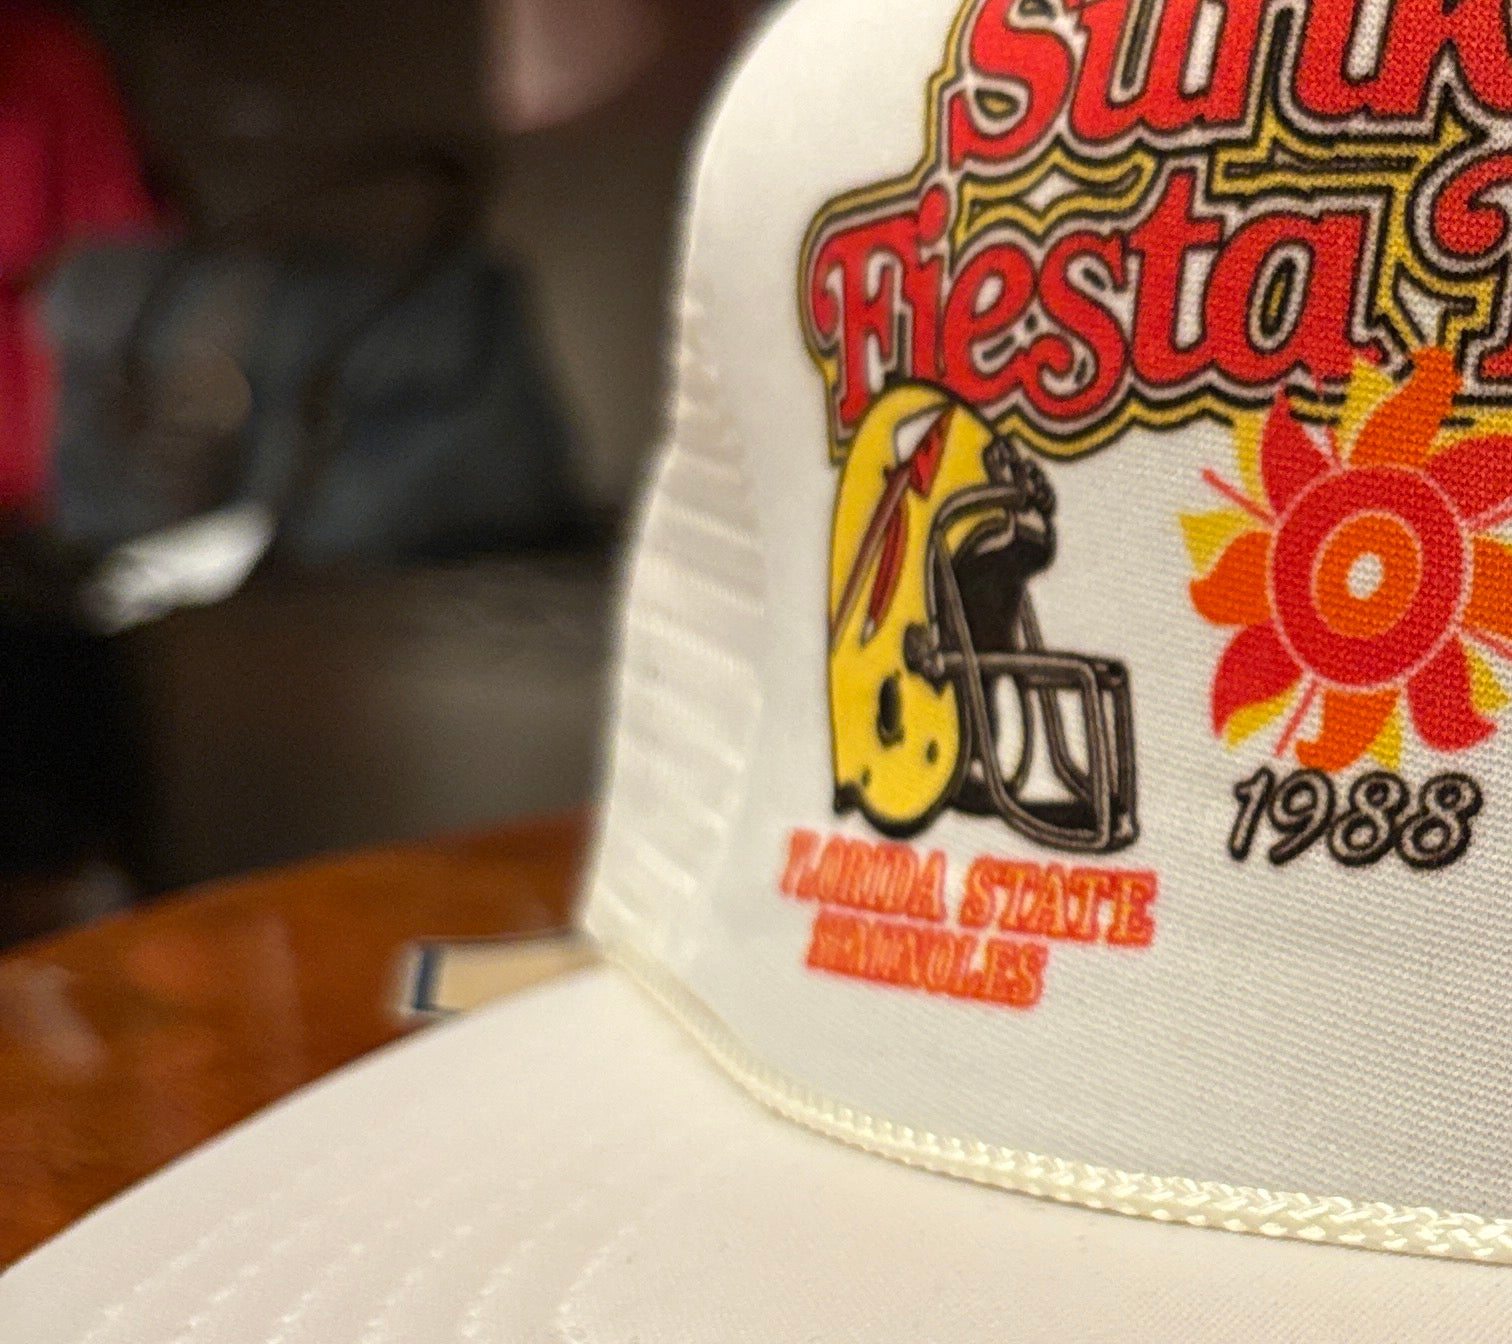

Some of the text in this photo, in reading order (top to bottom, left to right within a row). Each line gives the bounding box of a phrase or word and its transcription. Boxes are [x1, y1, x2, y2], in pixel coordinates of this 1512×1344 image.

[806, 162, 1392, 431] Fiesta
[1228, 765, 1483, 870] 1988
[957, 854, 1159, 948] STATE
